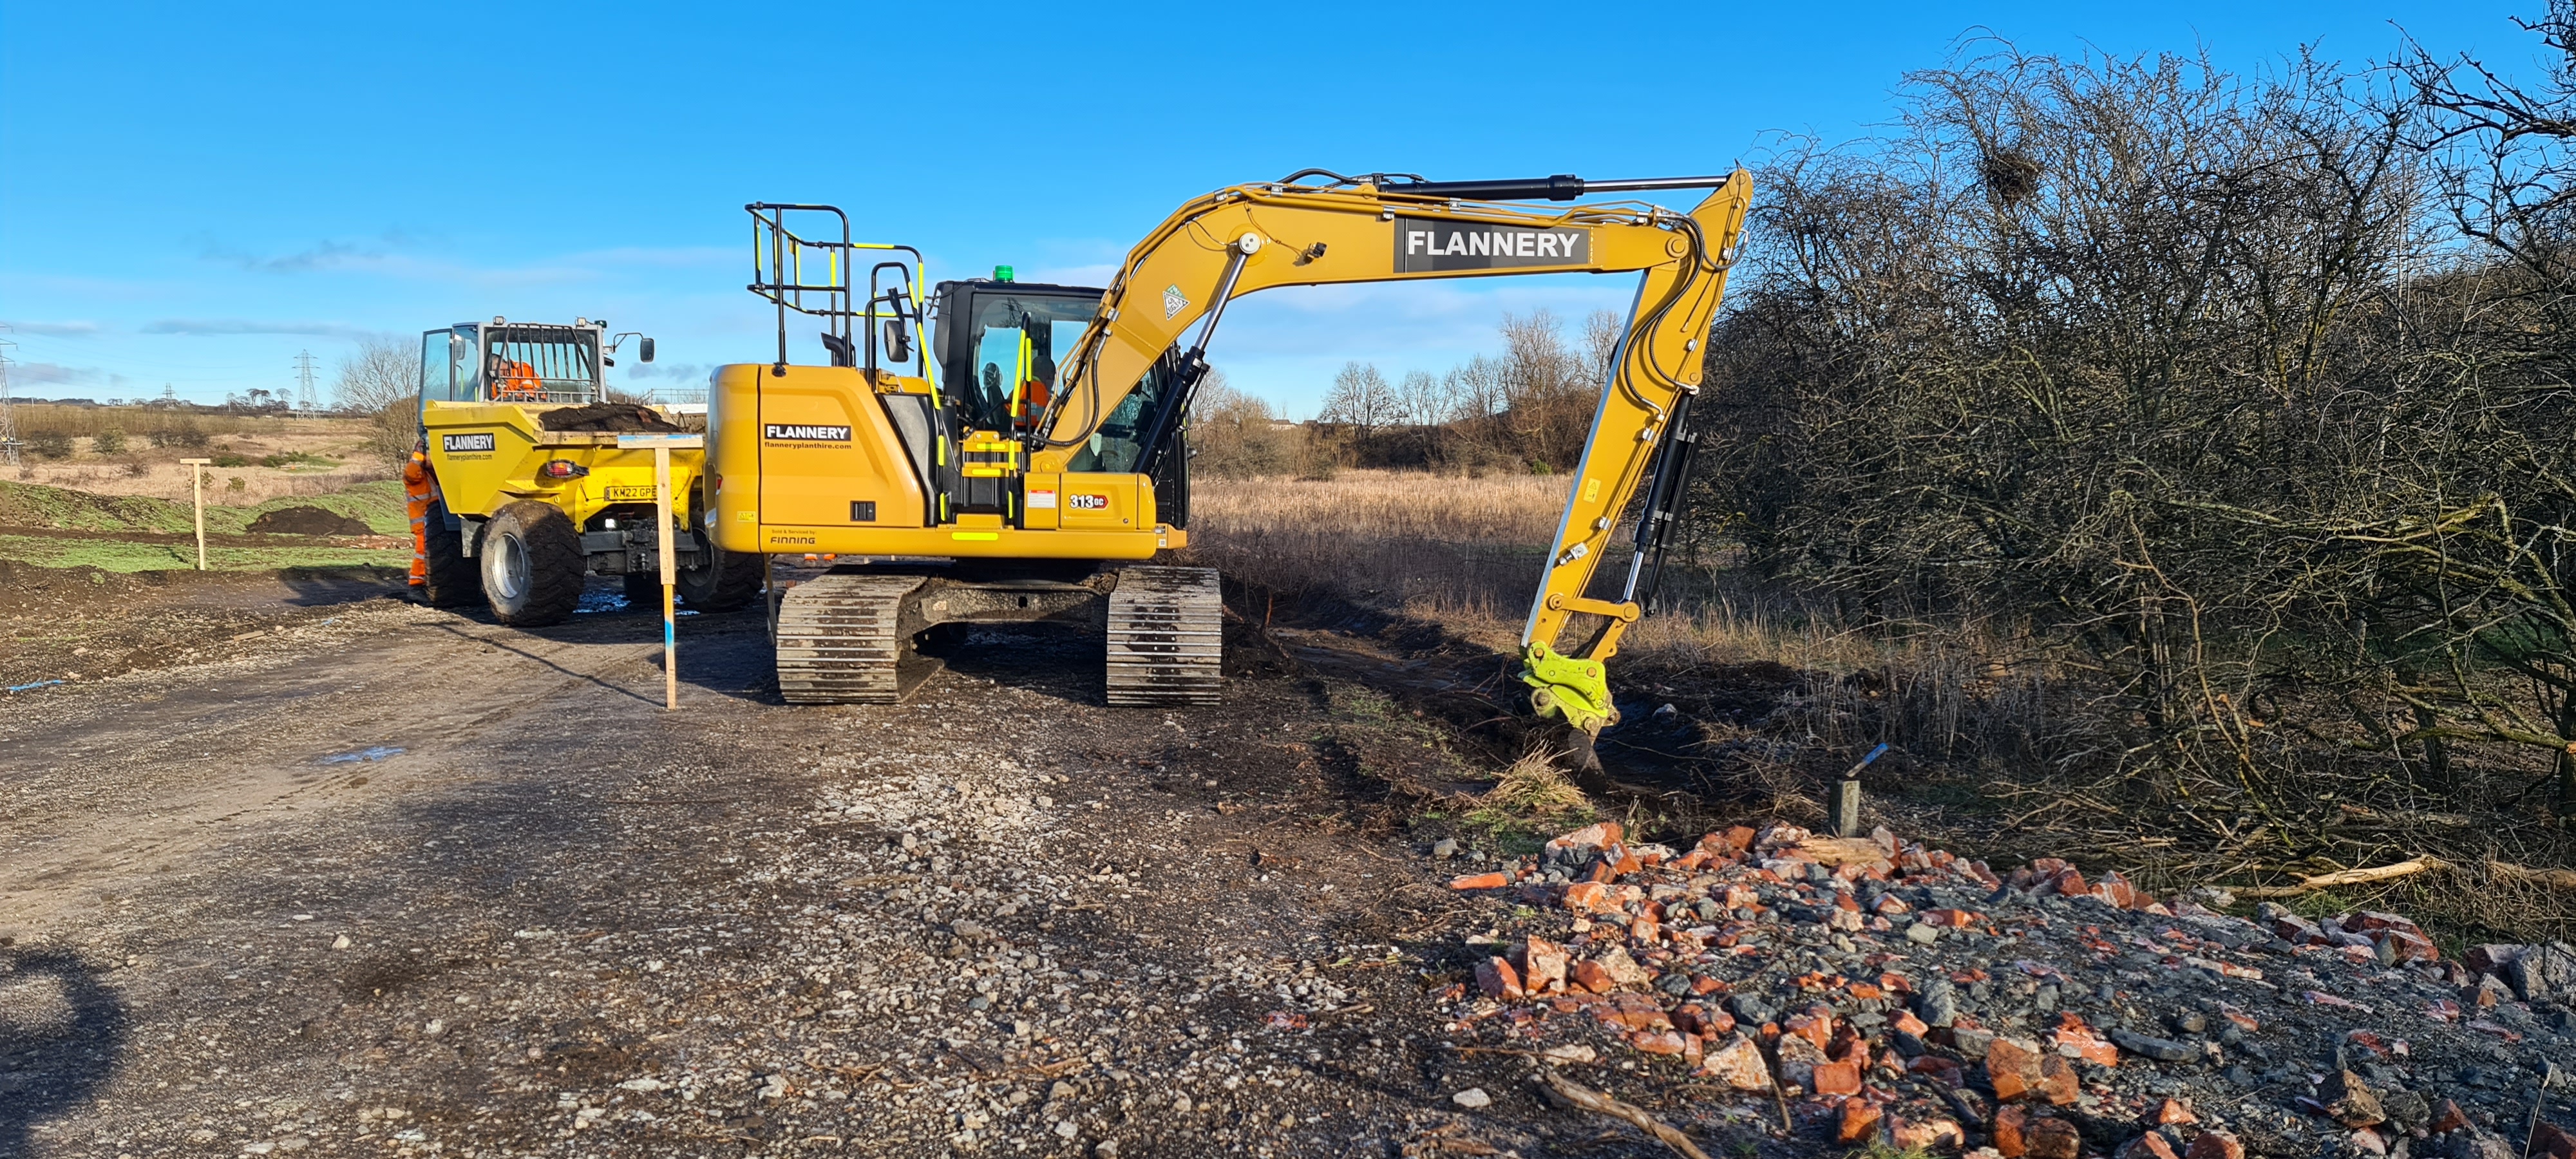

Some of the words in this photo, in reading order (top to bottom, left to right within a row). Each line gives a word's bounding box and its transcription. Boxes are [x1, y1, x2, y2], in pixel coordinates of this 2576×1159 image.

[1407, 231, 1580, 258] FLANNERY
[766, 425, 848, 439] FLANNERY
[444, 435, 493, 450] FLANNERY
[447, 453, 493, 462] flanneryplanthire.com
[613, 488, 637, 497] KM22
[1070, 495, 1094, 509] 313
[770, 536, 816, 545] FINNING
